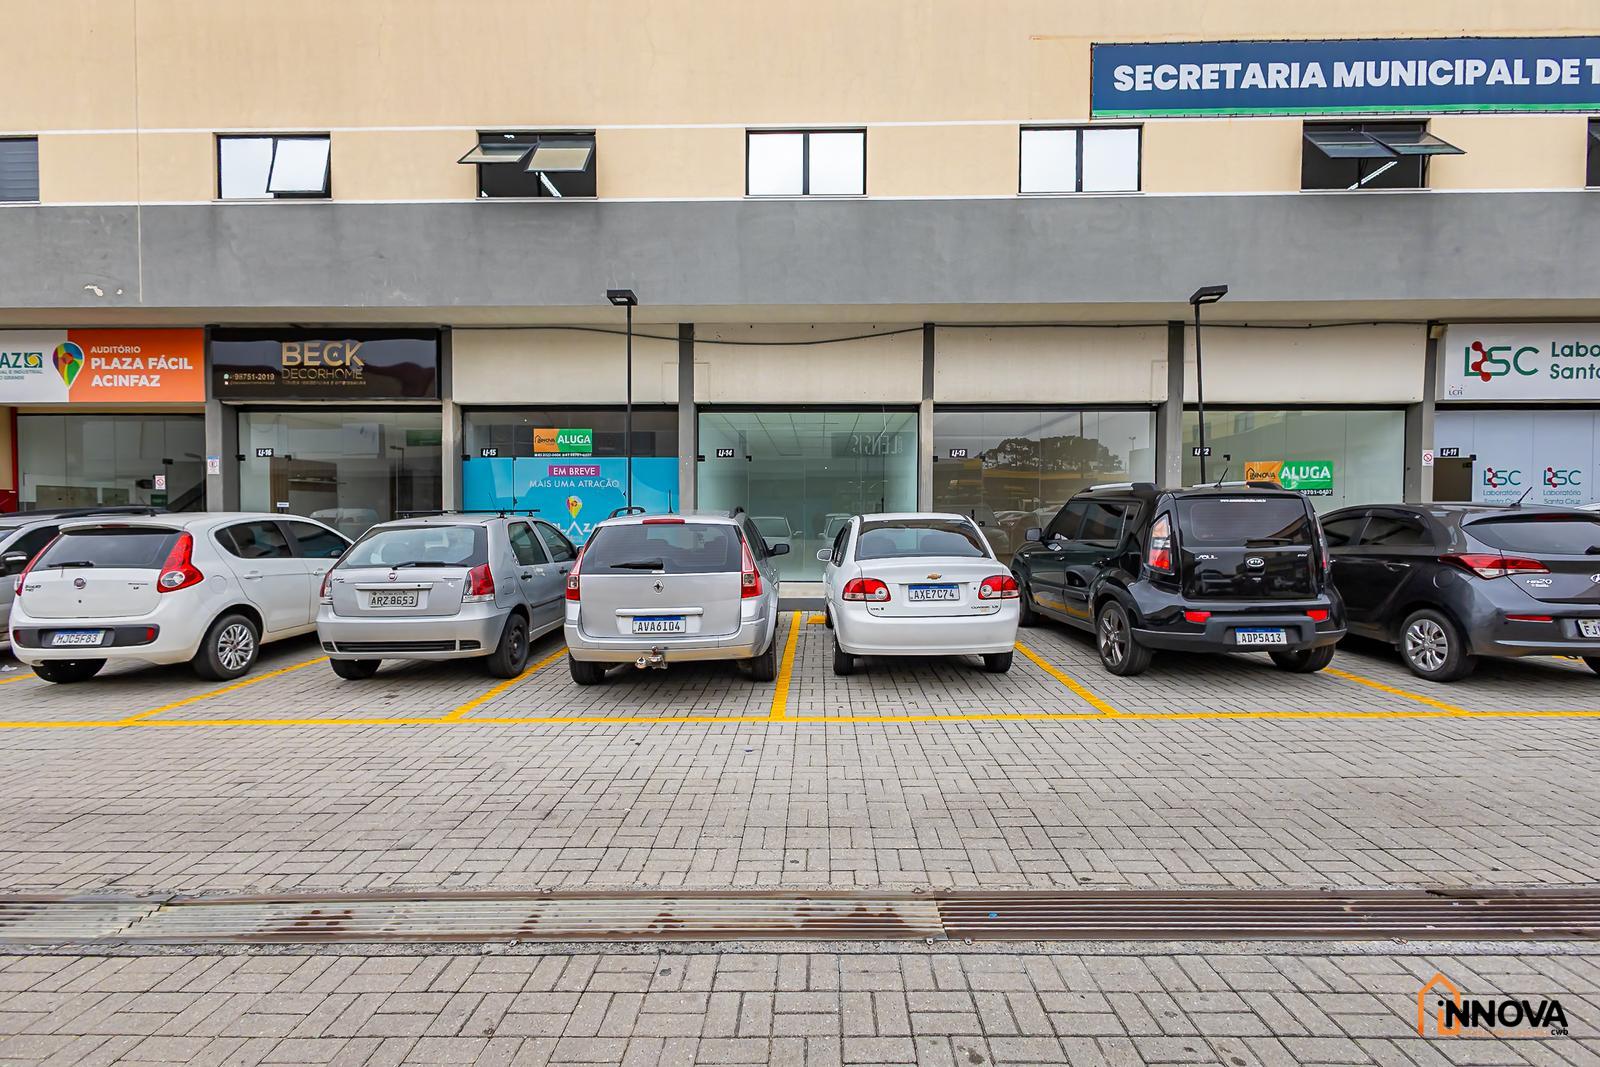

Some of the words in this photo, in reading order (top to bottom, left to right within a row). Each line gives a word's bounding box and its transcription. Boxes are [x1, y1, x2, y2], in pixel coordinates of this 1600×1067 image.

[1113, 61, 1328, 91] SECRETARIA
[1333, 58, 1530, 88] MUNICIPAL
[1536, 58, 1580, 85] DE
[91, 345, 141, 353] AUDITÓRIO
[281, 342, 365, 366] BECK
[1551, 341, 1600, 357] Labo
[91, 358, 144, 370] PLAZA
[148, 354, 193, 370] FÁCIL
[281, 368, 363, 379] DECORHOME
[91, 374, 160, 387] ACINFAZ
[557, 434, 591, 444] ALUGA
[553, 467, 566, 476] EM
[569, 467, 596, 476] BREVE
[1281, 466, 1331, 479] ALUGA
[529, 480, 552, 488] MAIS
[554, 480, 575, 488] UMA
[578, 478, 620, 490] ATRAÇÃO
[914, 589, 955, 600] AXE7C74
[1241, 633, 1281, 643] ADP5A13
